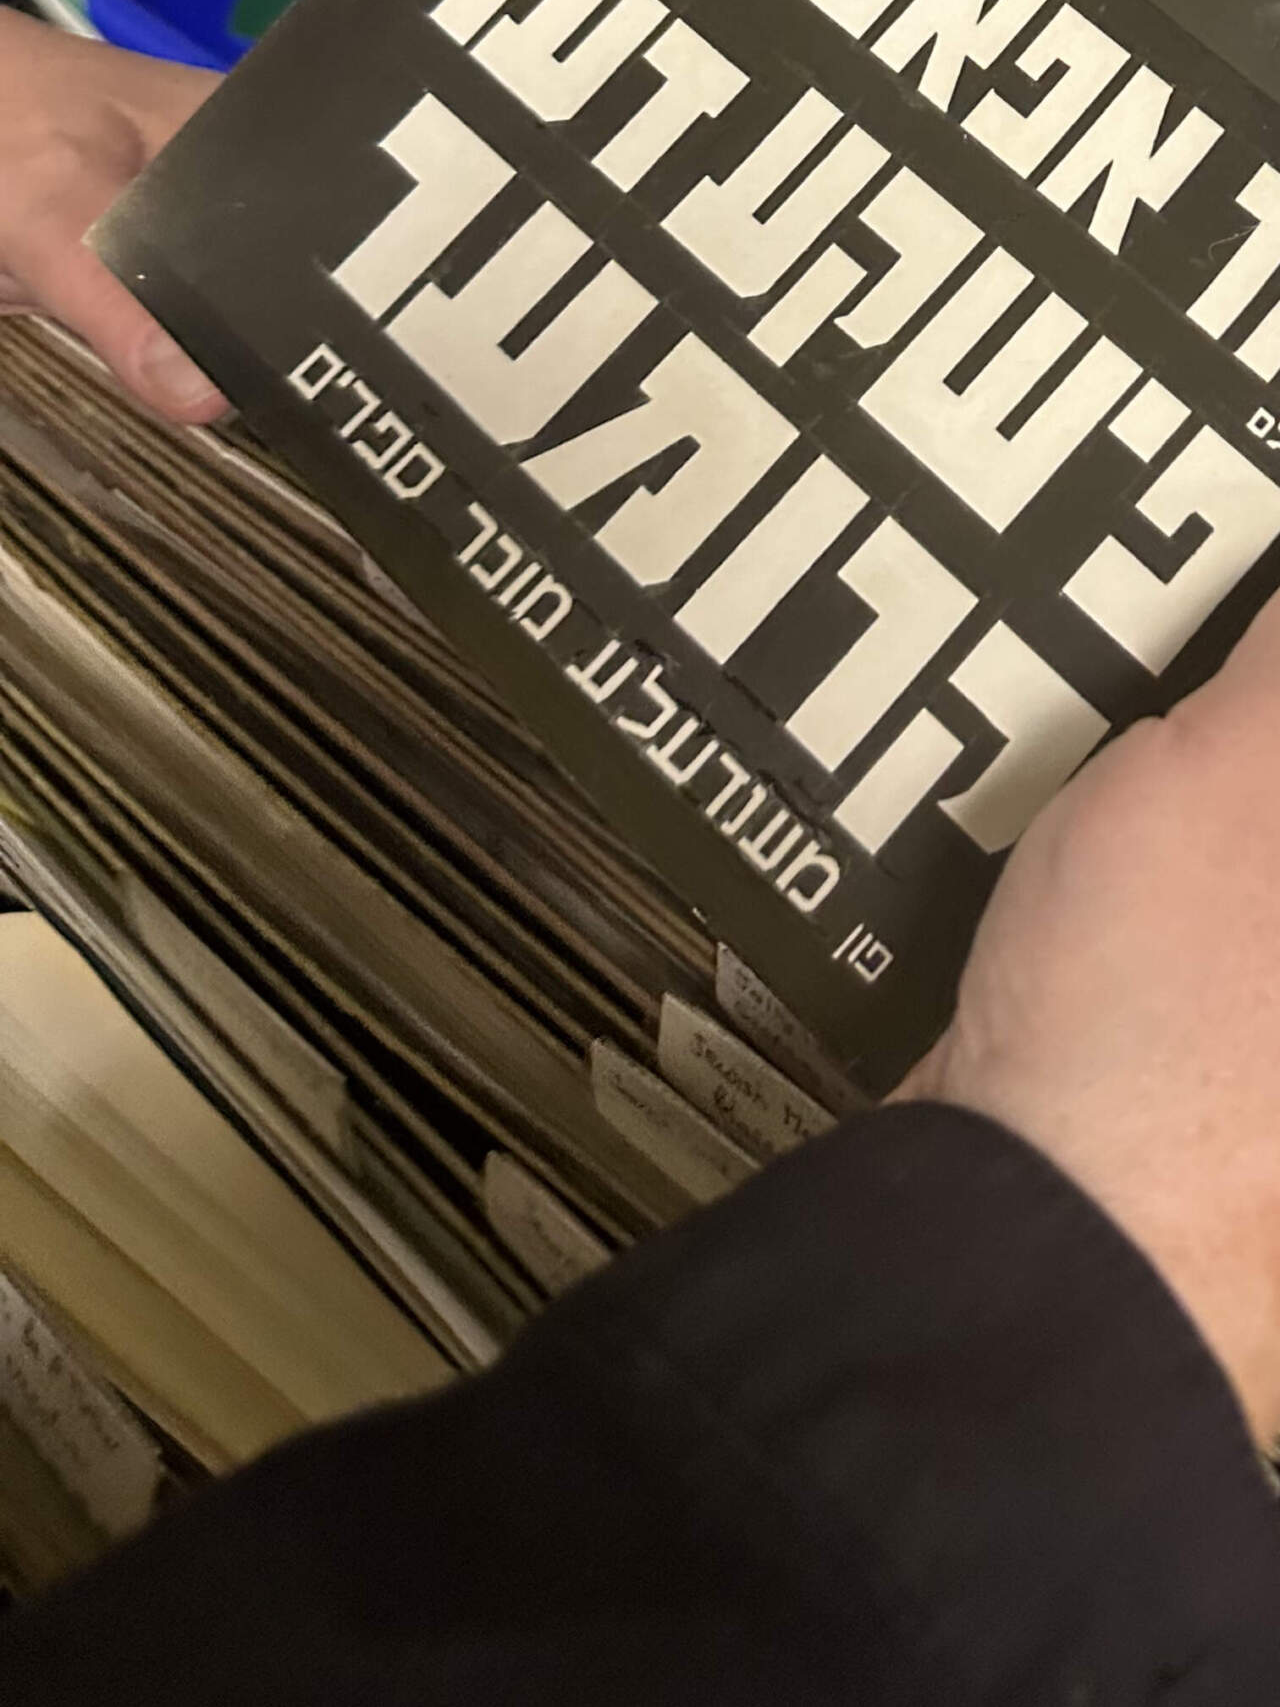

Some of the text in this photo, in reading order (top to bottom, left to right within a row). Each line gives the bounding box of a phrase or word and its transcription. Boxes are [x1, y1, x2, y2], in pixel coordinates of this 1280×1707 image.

[286, 342, 446, 500] ספרים
[329, 91, 1112, 854] קרומער
[453, 502, 574, 642] מוכר
[563, 637, 842, 914] מענדעלע
[830, 922, 895, 984] פון
